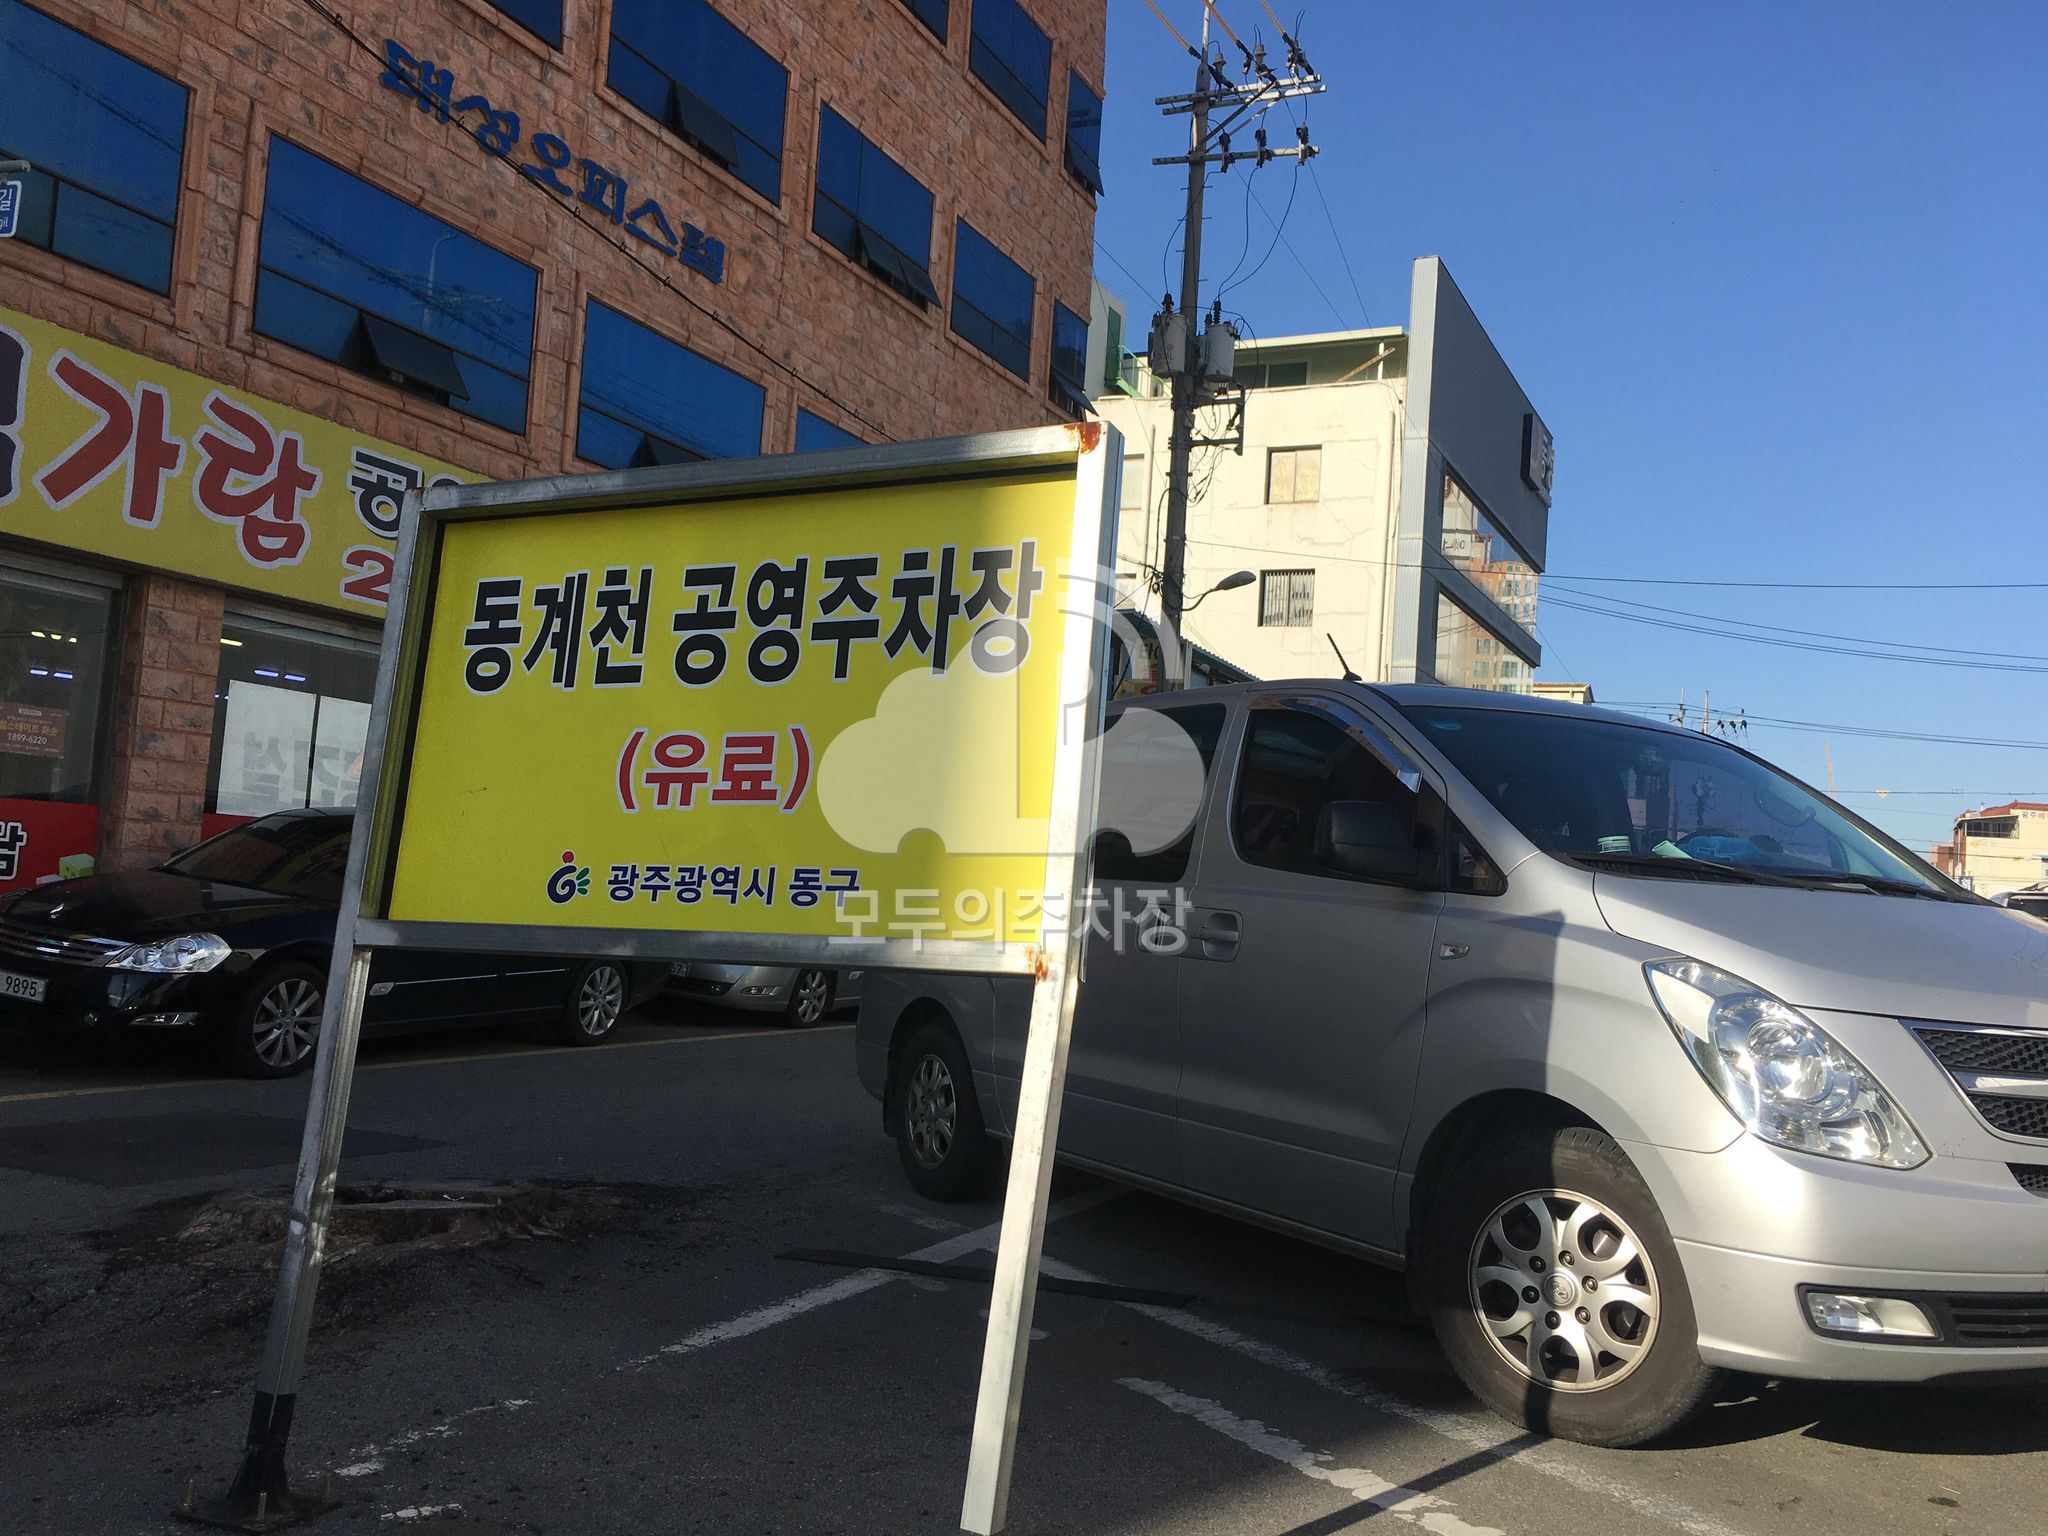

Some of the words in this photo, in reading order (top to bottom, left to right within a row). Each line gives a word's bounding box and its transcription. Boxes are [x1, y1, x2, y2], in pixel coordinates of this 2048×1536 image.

[463, 566, 653, 696] 동계천
[671, 537, 1044, 690] 공영주차장
[8, 732, 48, 745] 1899-6220
[614, 725, 814, 815] (유료)
[606, 863, 777, 906] 광주광역시
[788, 867, 861, 909] 동구
[6, 976, 38, 997] 9895
